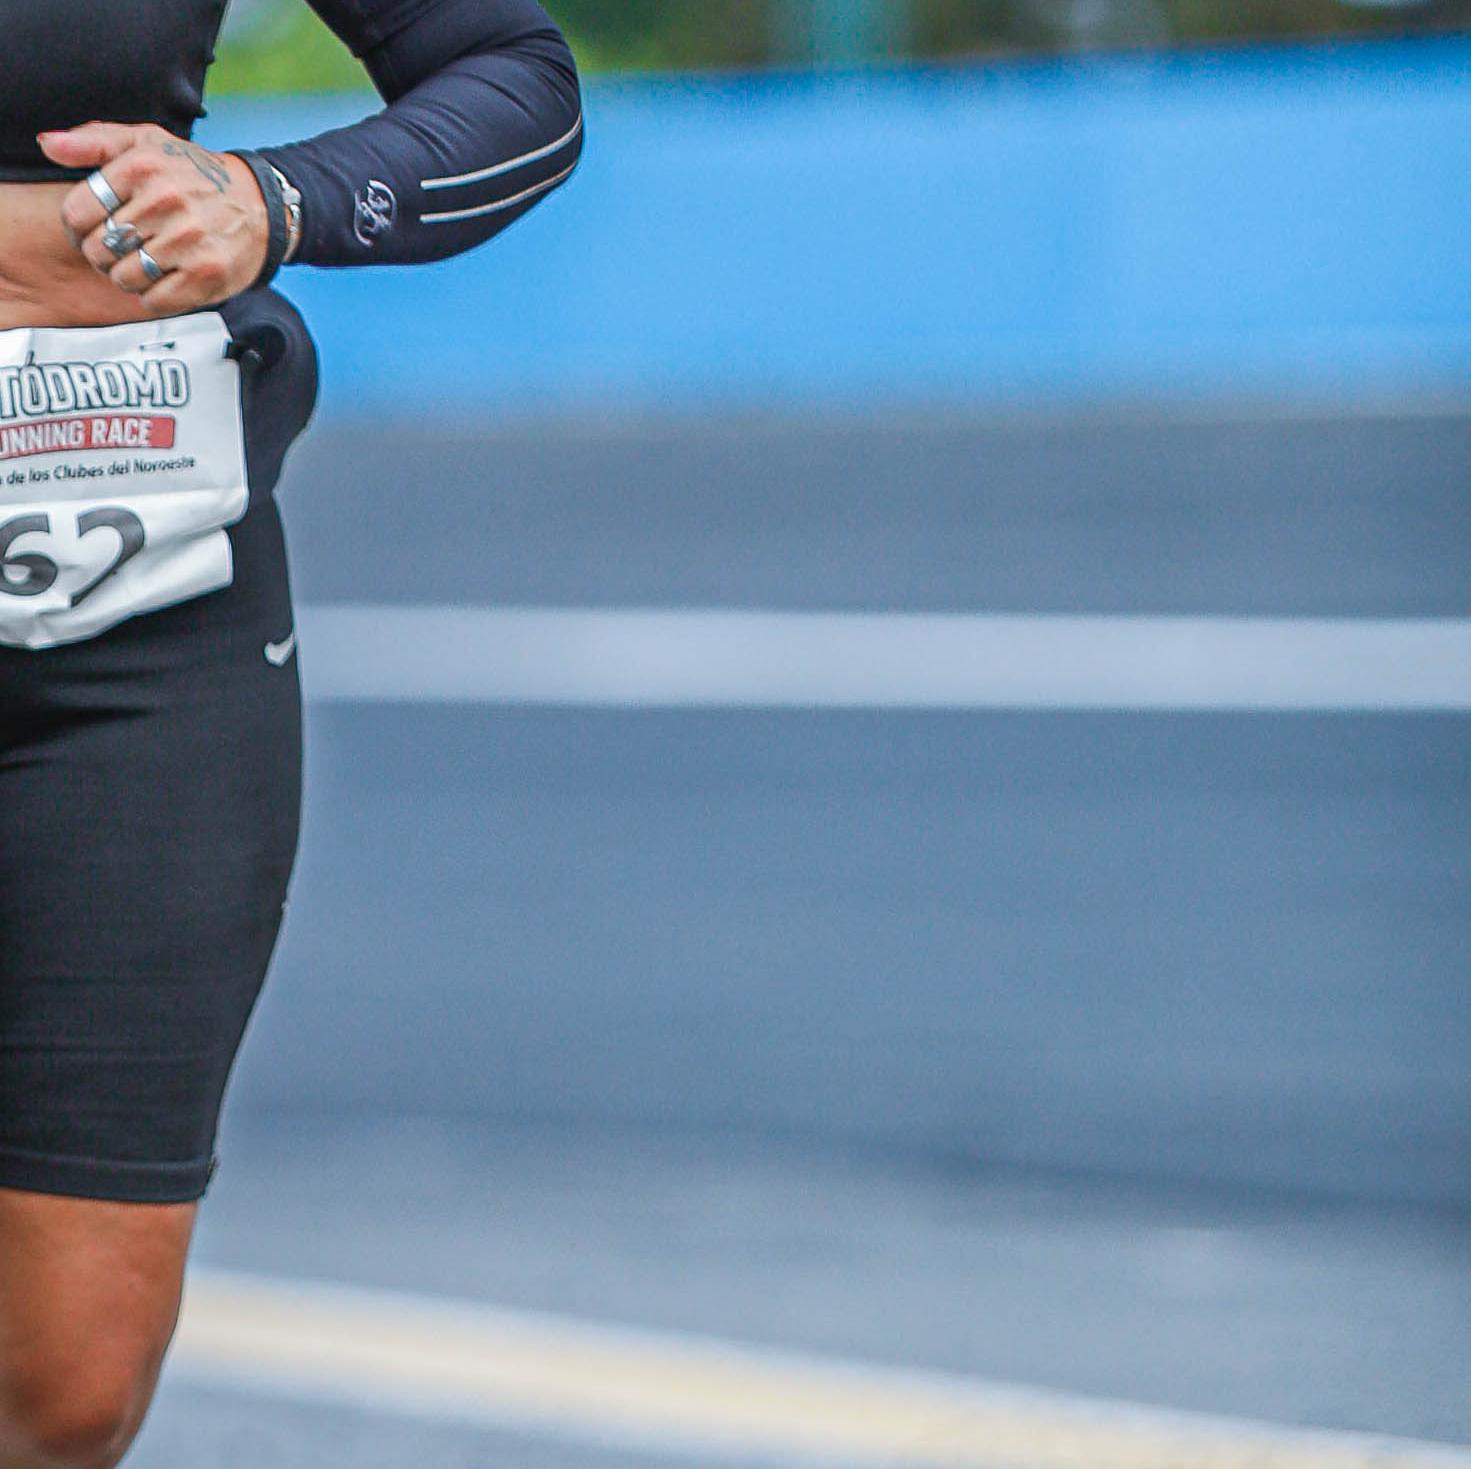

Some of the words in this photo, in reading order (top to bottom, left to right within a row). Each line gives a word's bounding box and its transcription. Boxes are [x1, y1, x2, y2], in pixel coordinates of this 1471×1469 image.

[90, 418, 152, 445] RACE
[6, 469, 26, 485] de
[28, 467, 50, 482] los
[53, 463, 104, 481] Clubes
[107, 459, 129, 476] del
[133, 455, 197, 473] Noroeste
